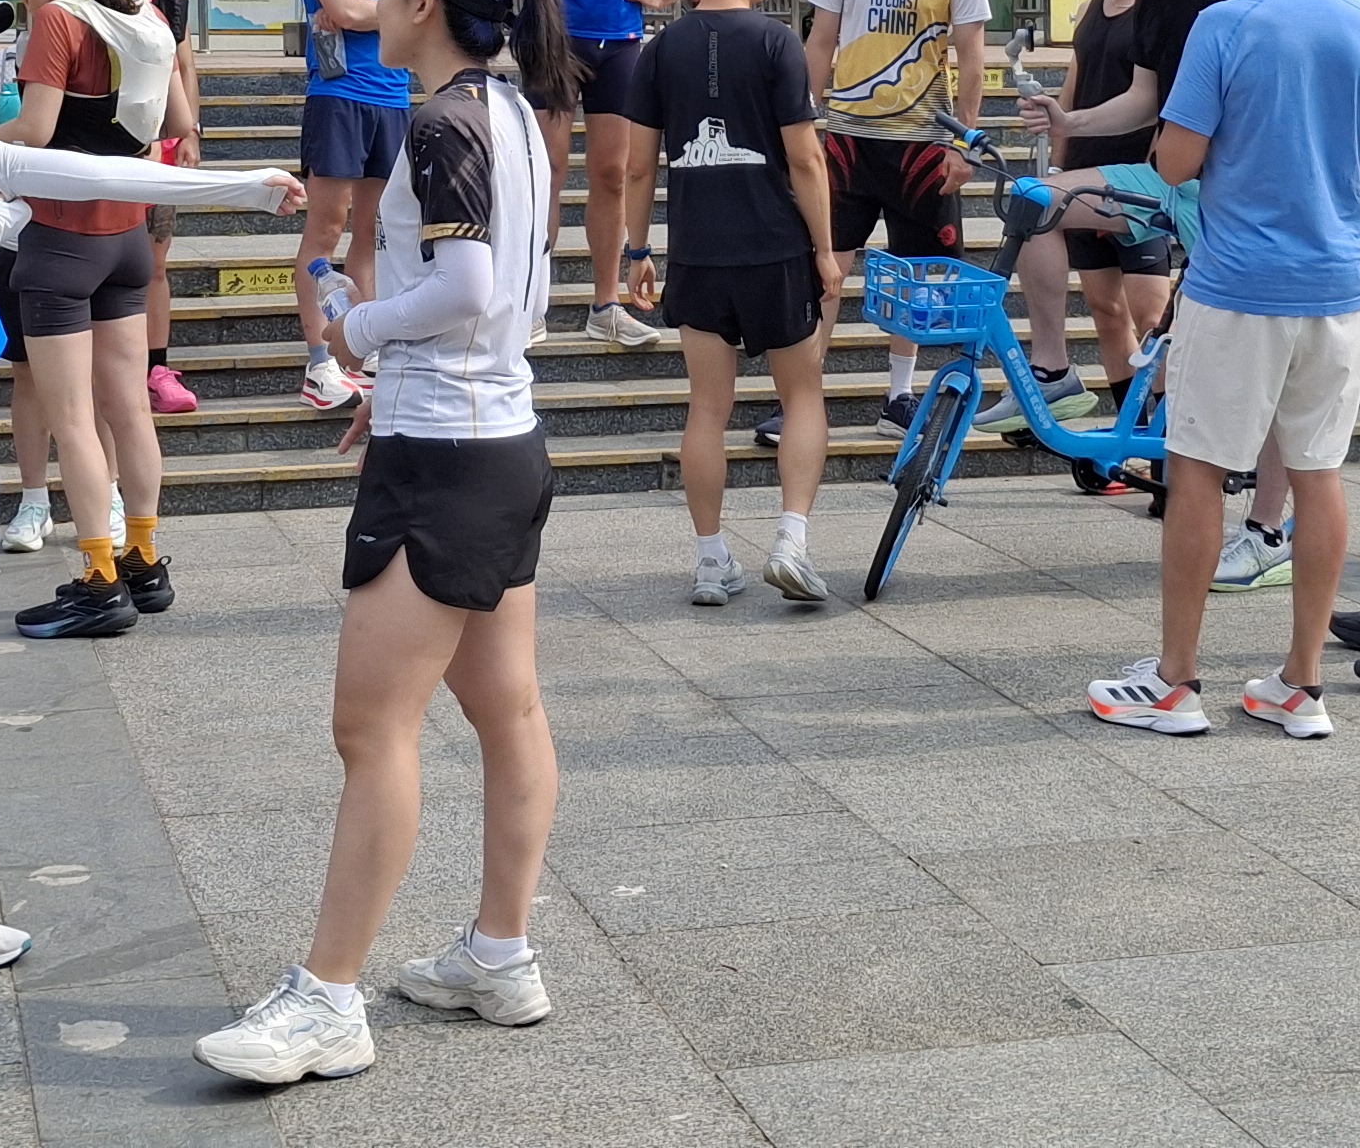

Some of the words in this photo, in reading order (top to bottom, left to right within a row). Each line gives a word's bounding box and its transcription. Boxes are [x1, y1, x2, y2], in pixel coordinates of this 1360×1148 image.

[867, 7, 918, 36] CHINA
[683, 140, 719, 166] 100
[249, 273, 296, 285] 小心台
